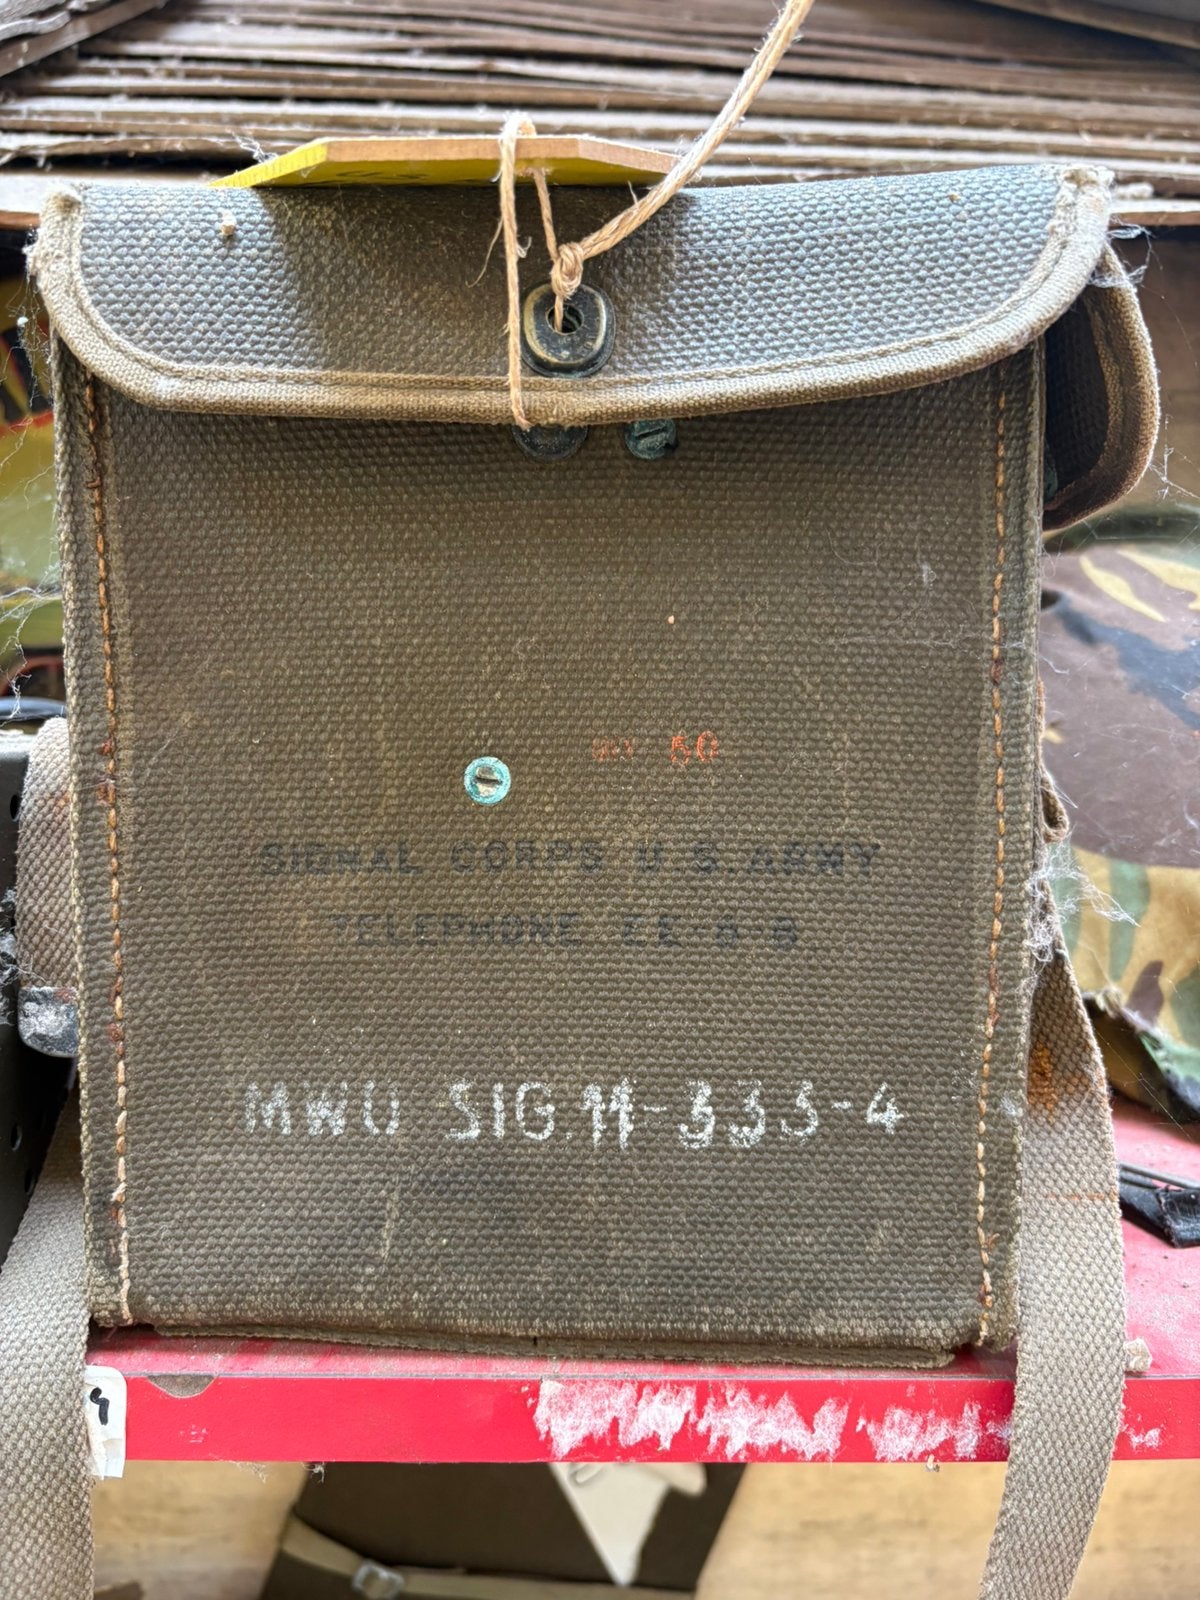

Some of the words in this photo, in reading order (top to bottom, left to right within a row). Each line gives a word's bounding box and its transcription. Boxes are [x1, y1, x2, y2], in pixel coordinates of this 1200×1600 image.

[669, 730, 719, 768] 50
[260, 843, 424, 876] SIGNAL
[451, 841, 603, 874] CORPS
[332, 913, 582, 946] TELEPHONE
